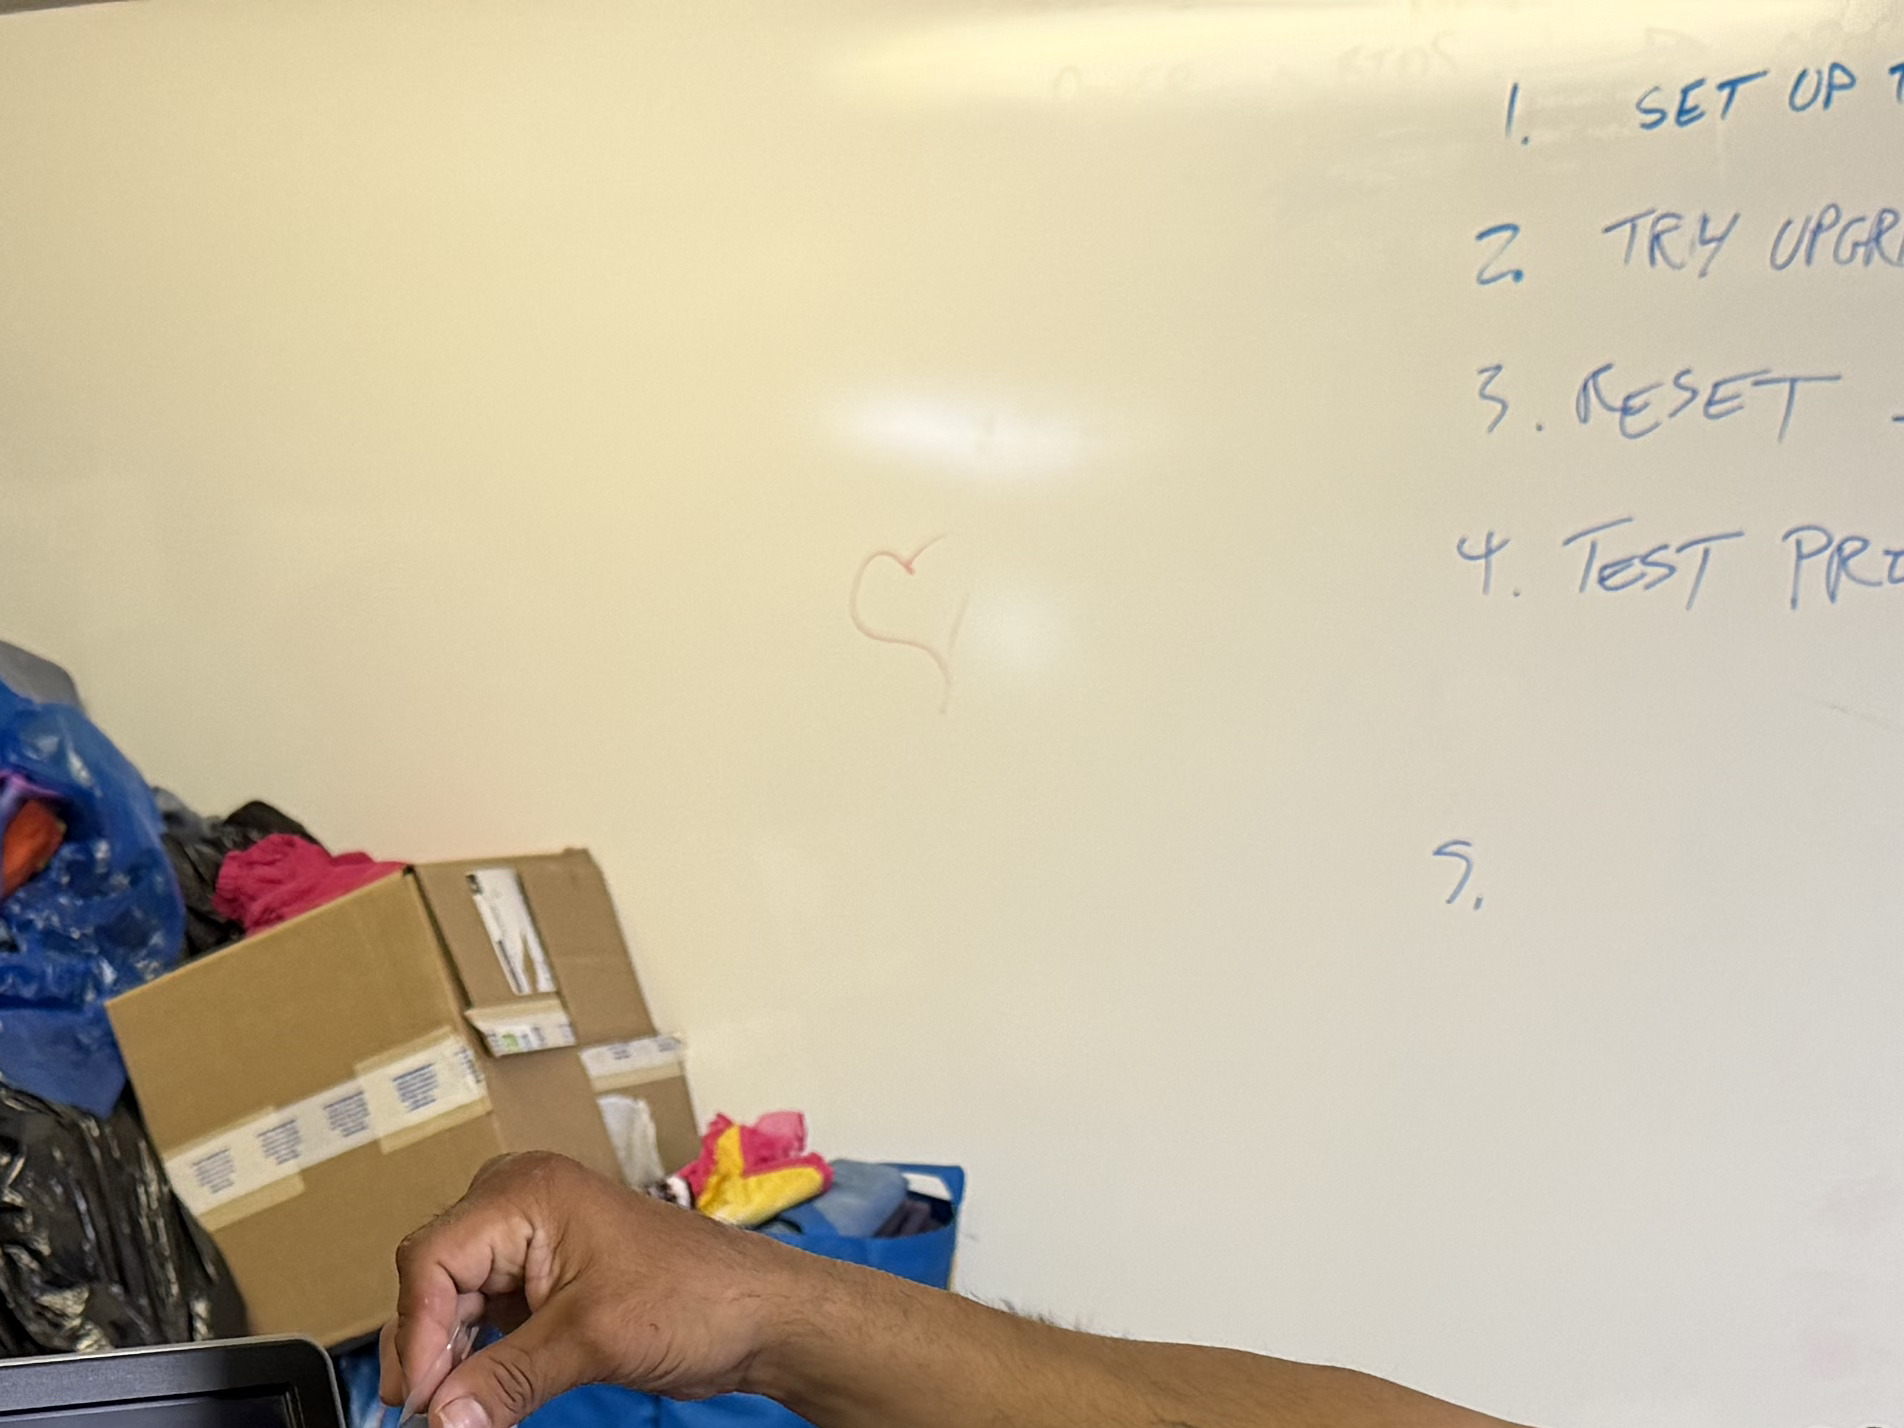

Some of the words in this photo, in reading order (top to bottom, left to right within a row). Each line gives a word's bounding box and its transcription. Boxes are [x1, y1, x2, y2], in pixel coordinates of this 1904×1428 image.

[1505, 82, 1530, 146] 1.
[1635, 70, 1769, 131] SET
[1788, 61, 1857, 113] UP
[1601, 207, 1741, 278] TRY
[1477, 362, 1545, 434] 3.
[1574, 362, 1843, 443] RESET
[1456, 530, 1521, 598] 4.
[1562, 516, 1746, 602] TEST
